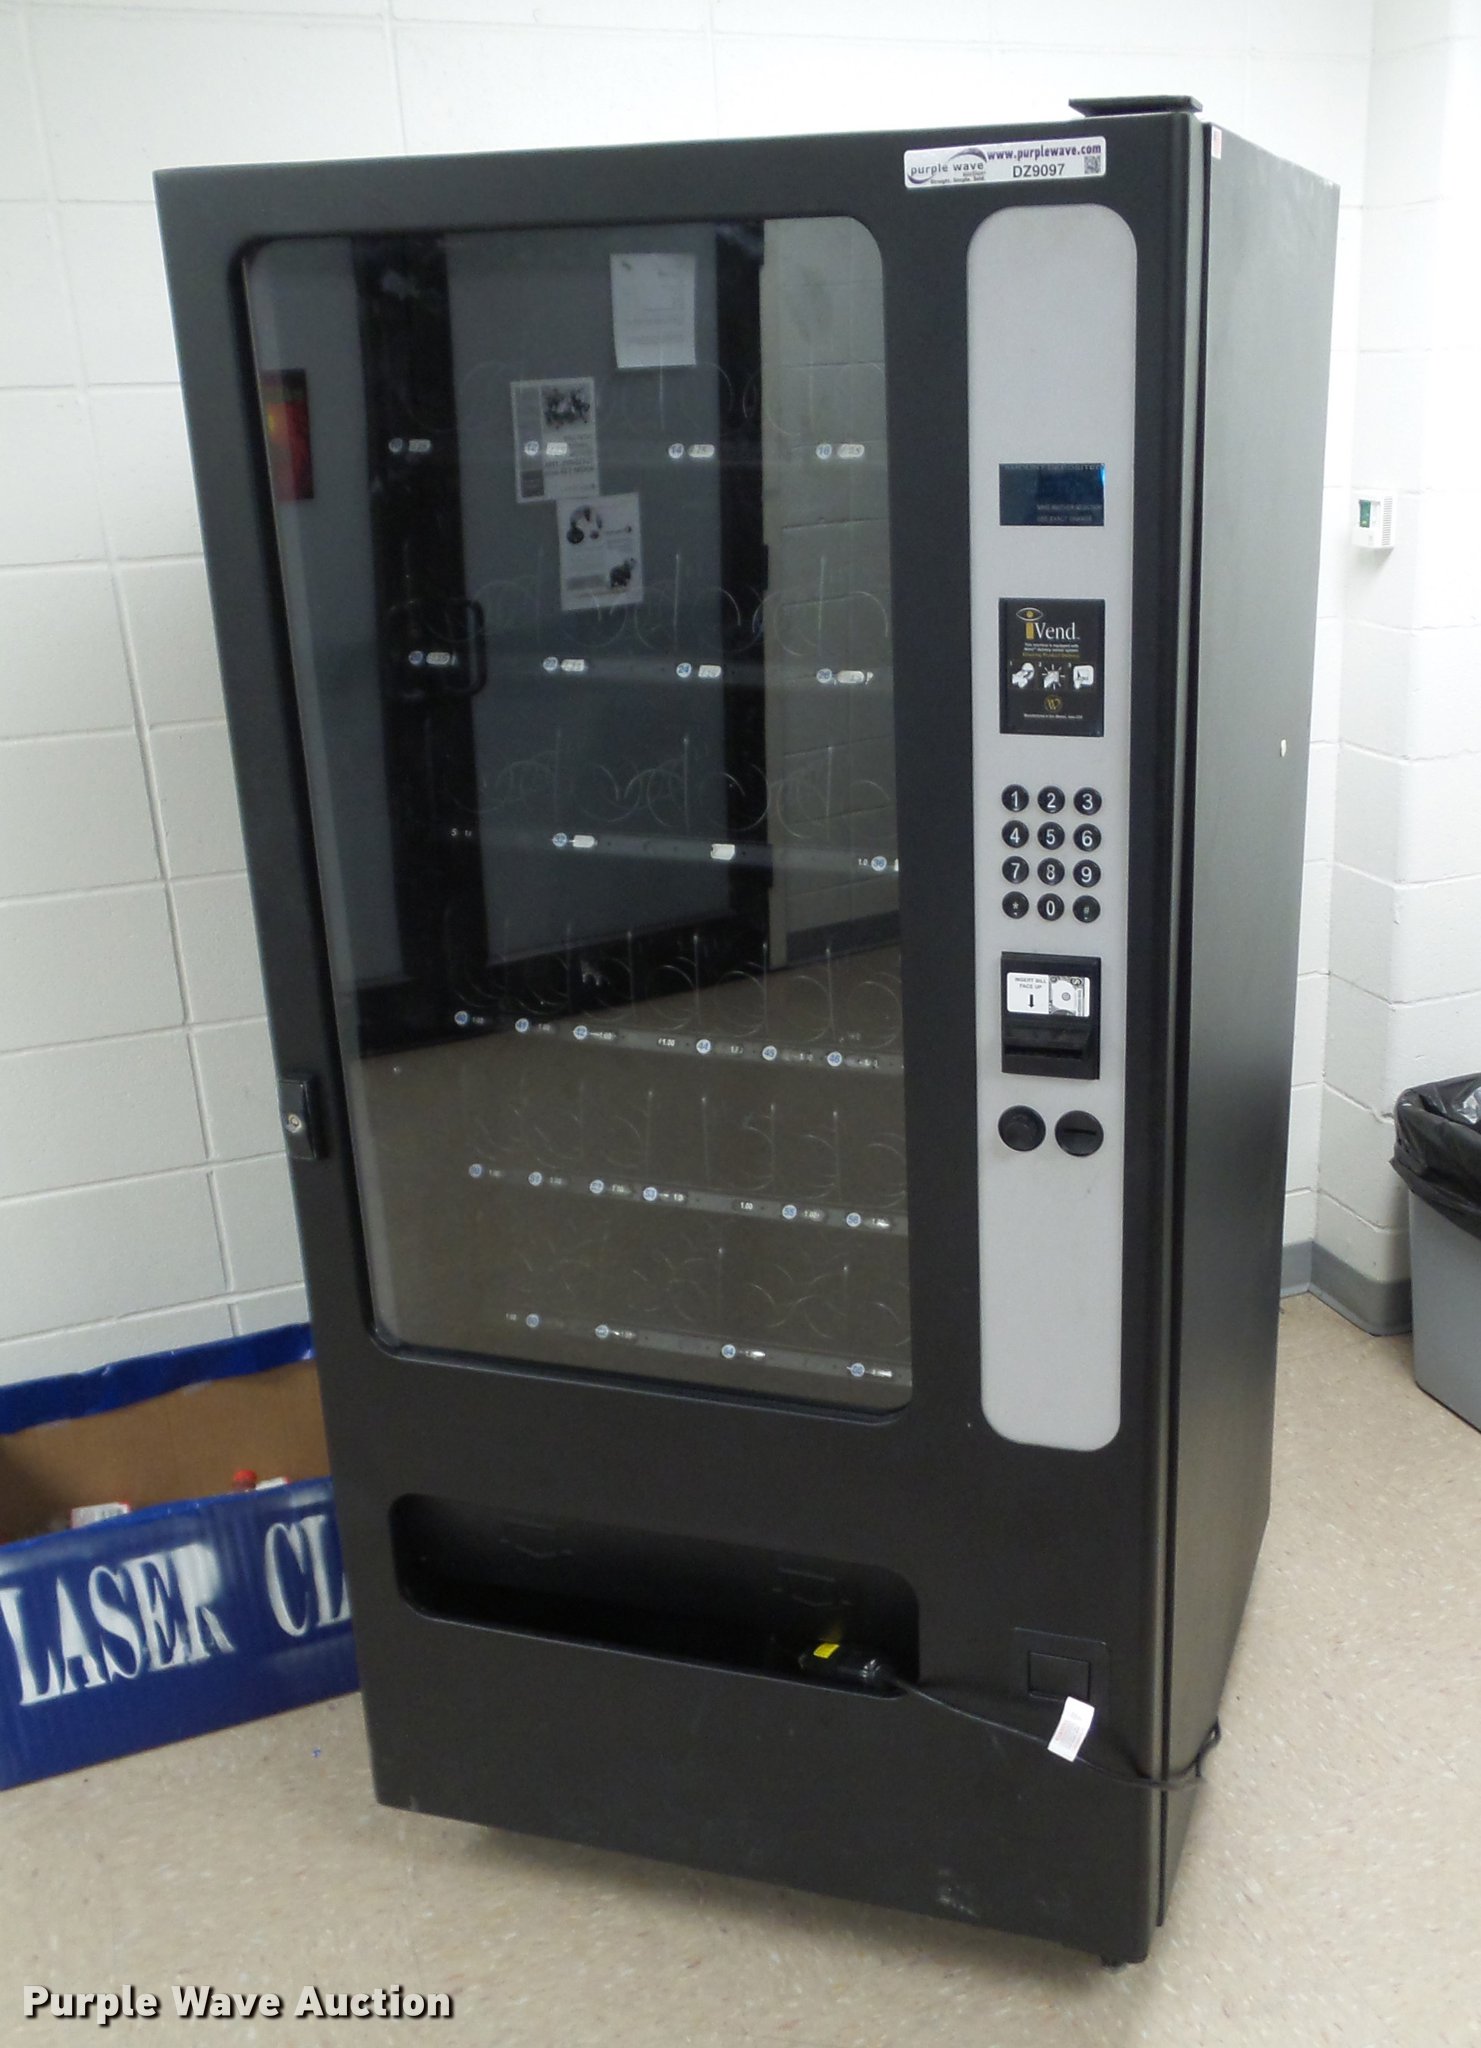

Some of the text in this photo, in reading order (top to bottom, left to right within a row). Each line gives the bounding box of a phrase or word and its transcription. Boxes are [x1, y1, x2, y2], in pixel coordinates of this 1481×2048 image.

[988, 144, 1101, 161] www.purplewave.com
[910, 162, 984, 176] purple wave
[1012, 164, 1065, 178] DZ9097
[1011, 791, 1093, 810] 1 2 3
[1009, 828, 1093, 847] 4 5 6
[1010, 863, 1092, 883] 7 8 9
[1046, 900, 1056, 916] 0
[0, 1543, 235, 1706] LASER
